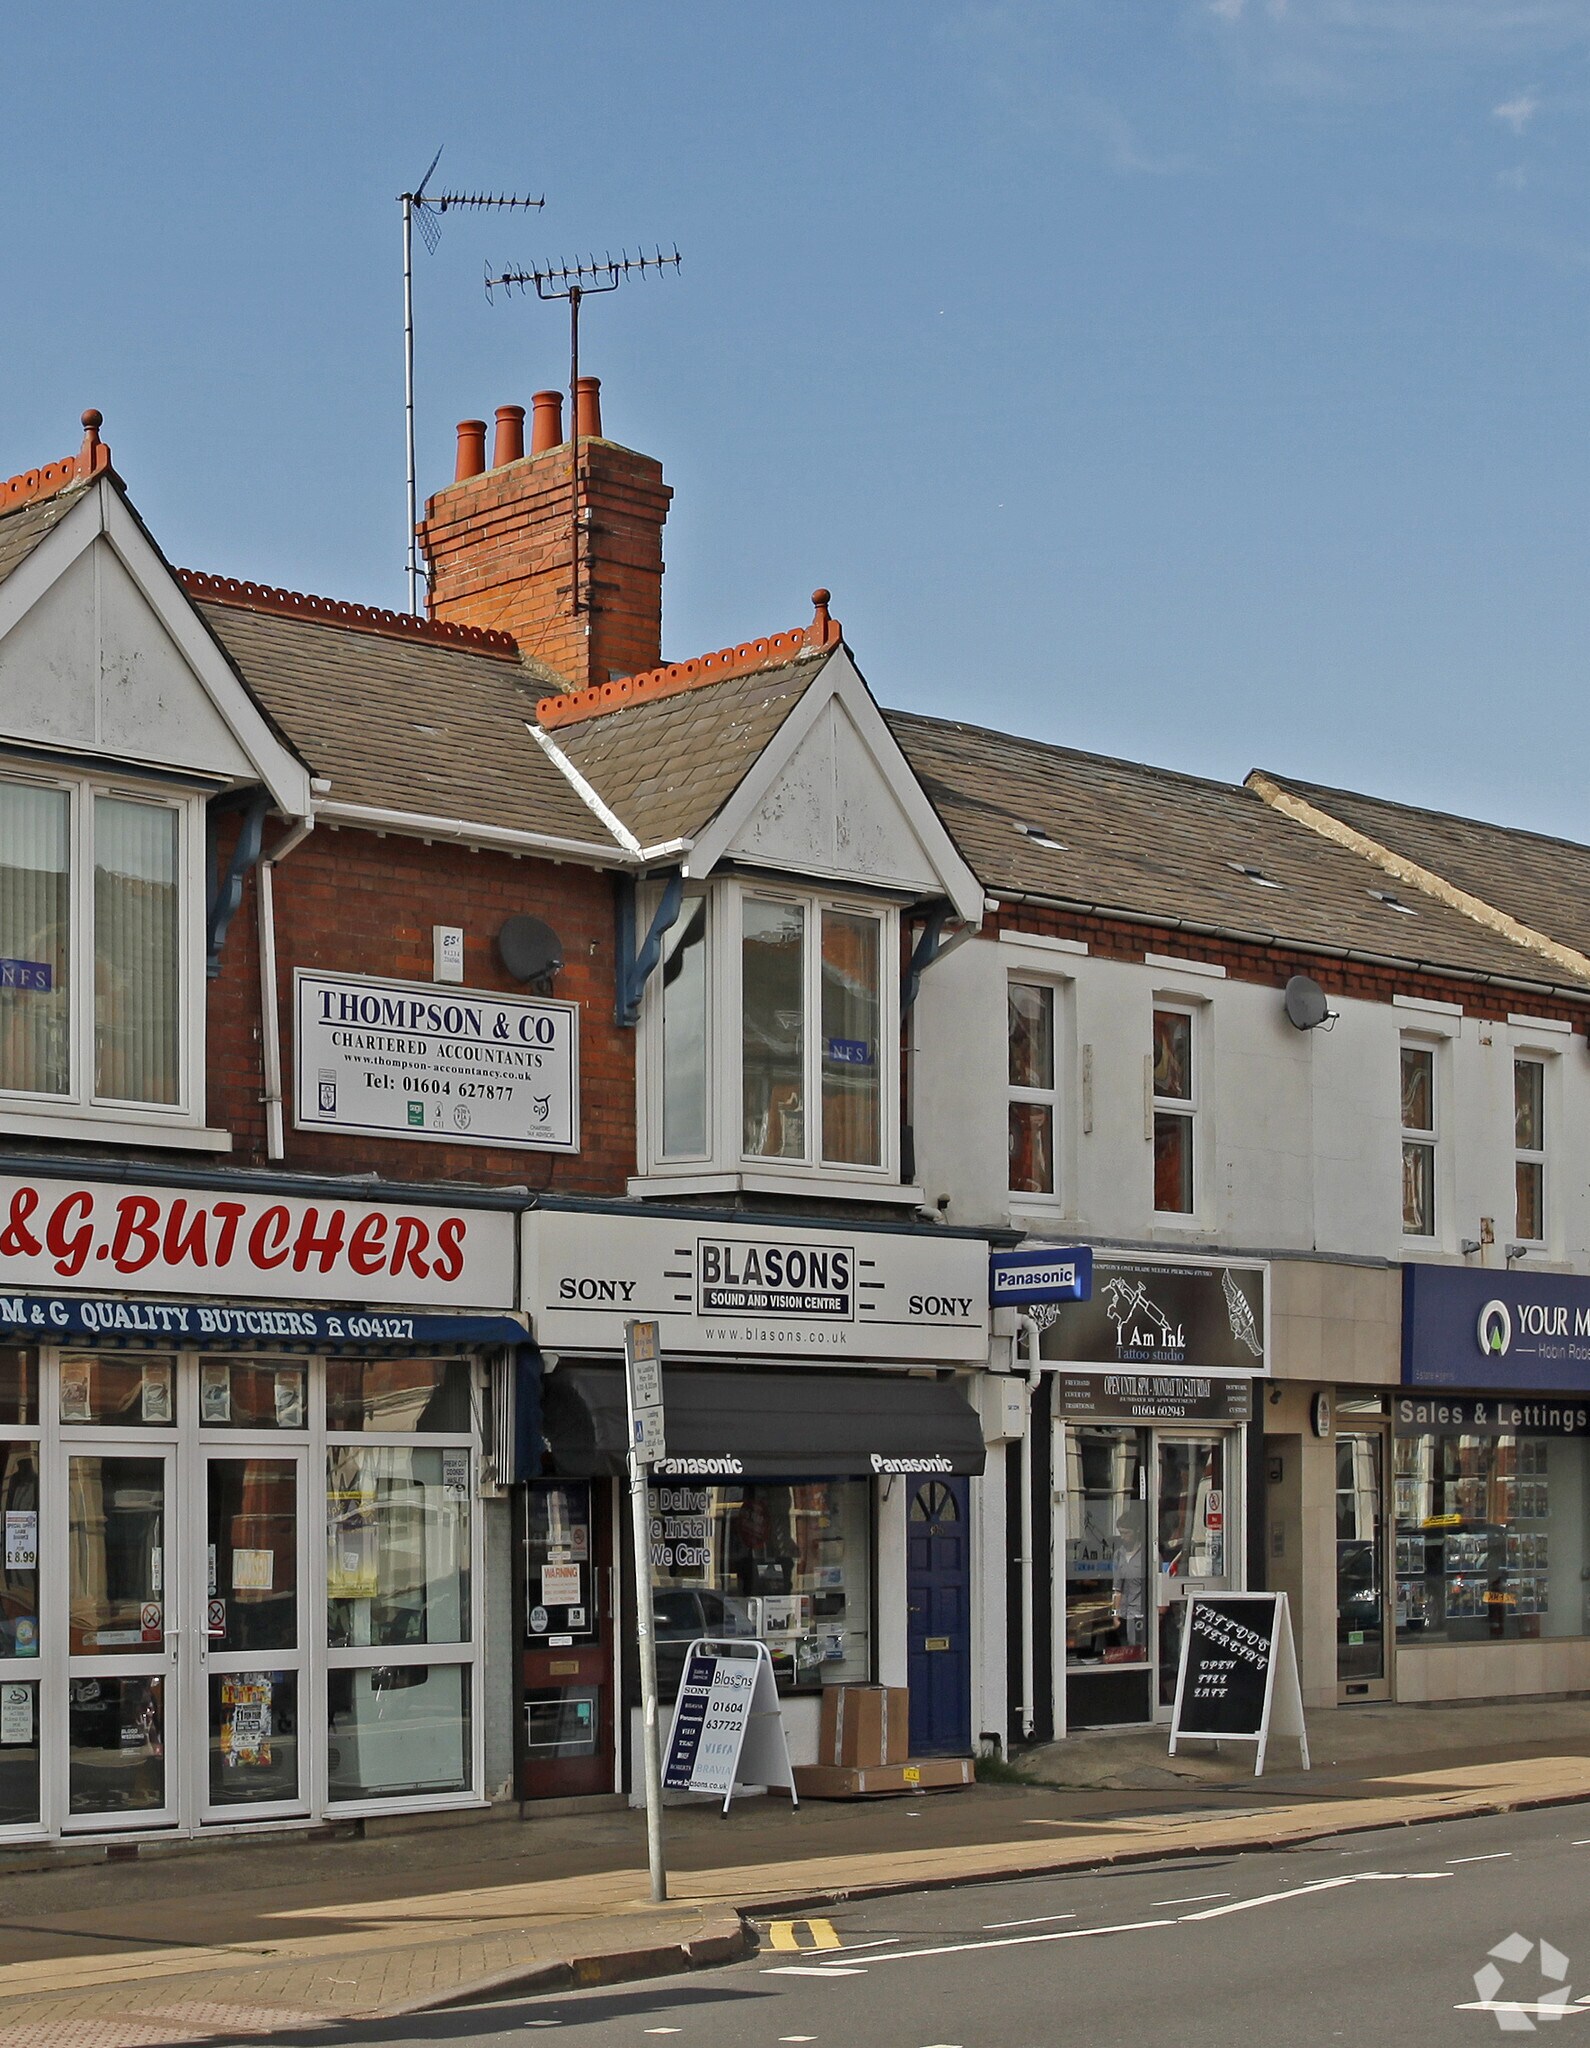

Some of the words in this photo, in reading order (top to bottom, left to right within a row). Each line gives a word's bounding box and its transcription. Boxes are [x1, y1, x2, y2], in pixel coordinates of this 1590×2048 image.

[318, 990, 483, 1037] THOMPSON
[492, 1012, 510, 1040] &
[519, 1015, 555, 1044] CO
[332, 1031, 427, 1055] CHARTERED
[436, 1043, 543, 1068] ACCOUNTANTS
[363, 1072, 395, 1090] Tel:
[402, 1075, 451, 1096] 01604
[458, 1082, 513, 1102] 627877
[703, 1246, 849, 1290] BLASONS
[997, 1267, 1073, 1287] Panasonic
[559, 1278, 636, 1302] SONY
[710, 1292, 745, 1307] SOUND
[747, 1293, 767, 1308] AND
[770, 1294, 803, 1309] VISION
[805, 1296, 841, 1311] CENTRE
[909, 1295, 973, 1316] SONY
[80, 1302, 189, 1332] QUALITY
[197, 1308, 318, 1335] BUTCHERS
[348, 1316, 414, 1339] 604127
[1517, 1304, 1569, 1336] YOUR
[705, 1327, 847, 1344] www.blasons.co.uk
[1130, 1325, 1155, 1347] Am
[1160, 1323, 1186, 1348] Ink
[1116, 1345, 1149, 1360] Tattoo
[1152, 1347, 1184, 1362] studio
[1132, 1405, 1156, 1416] 01604
[1400, 1399, 1463, 1424] Sales
[1473, 1403, 1487, 1425] &
[1497, 1404, 1586, 1432] Lettings
[870, 1454, 953, 1474] Panasonic
[660, 1487, 711, 1511] Deliver
[665, 1516, 714, 1539] Install
[675, 1543, 711, 1566] Care
[544, 1567, 578, 1578] WARNING
[1194, 1603, 1271, 1652] TATTOOS
[1192, 1620, 1269, 1670] PIERCING
[1199, 1660, 1237, 1670] OPEN
[714, 1670, 753, 1687] Blasons
[1198, 1674, 1228, 1684] TILL
[684, 1686, 711, 1695] SONY
[1194, 1687, 1228, 1698] LATE
[713, 1702, 743, 1713] 01604
[679, 1714, 704, 1723] Panasonic
[706, 1719, 743, 1732] 637722
[696, 1764, 731, 1775] BRAVIA
[666, 1777, 728, 1790] www.blasons.co.uk
